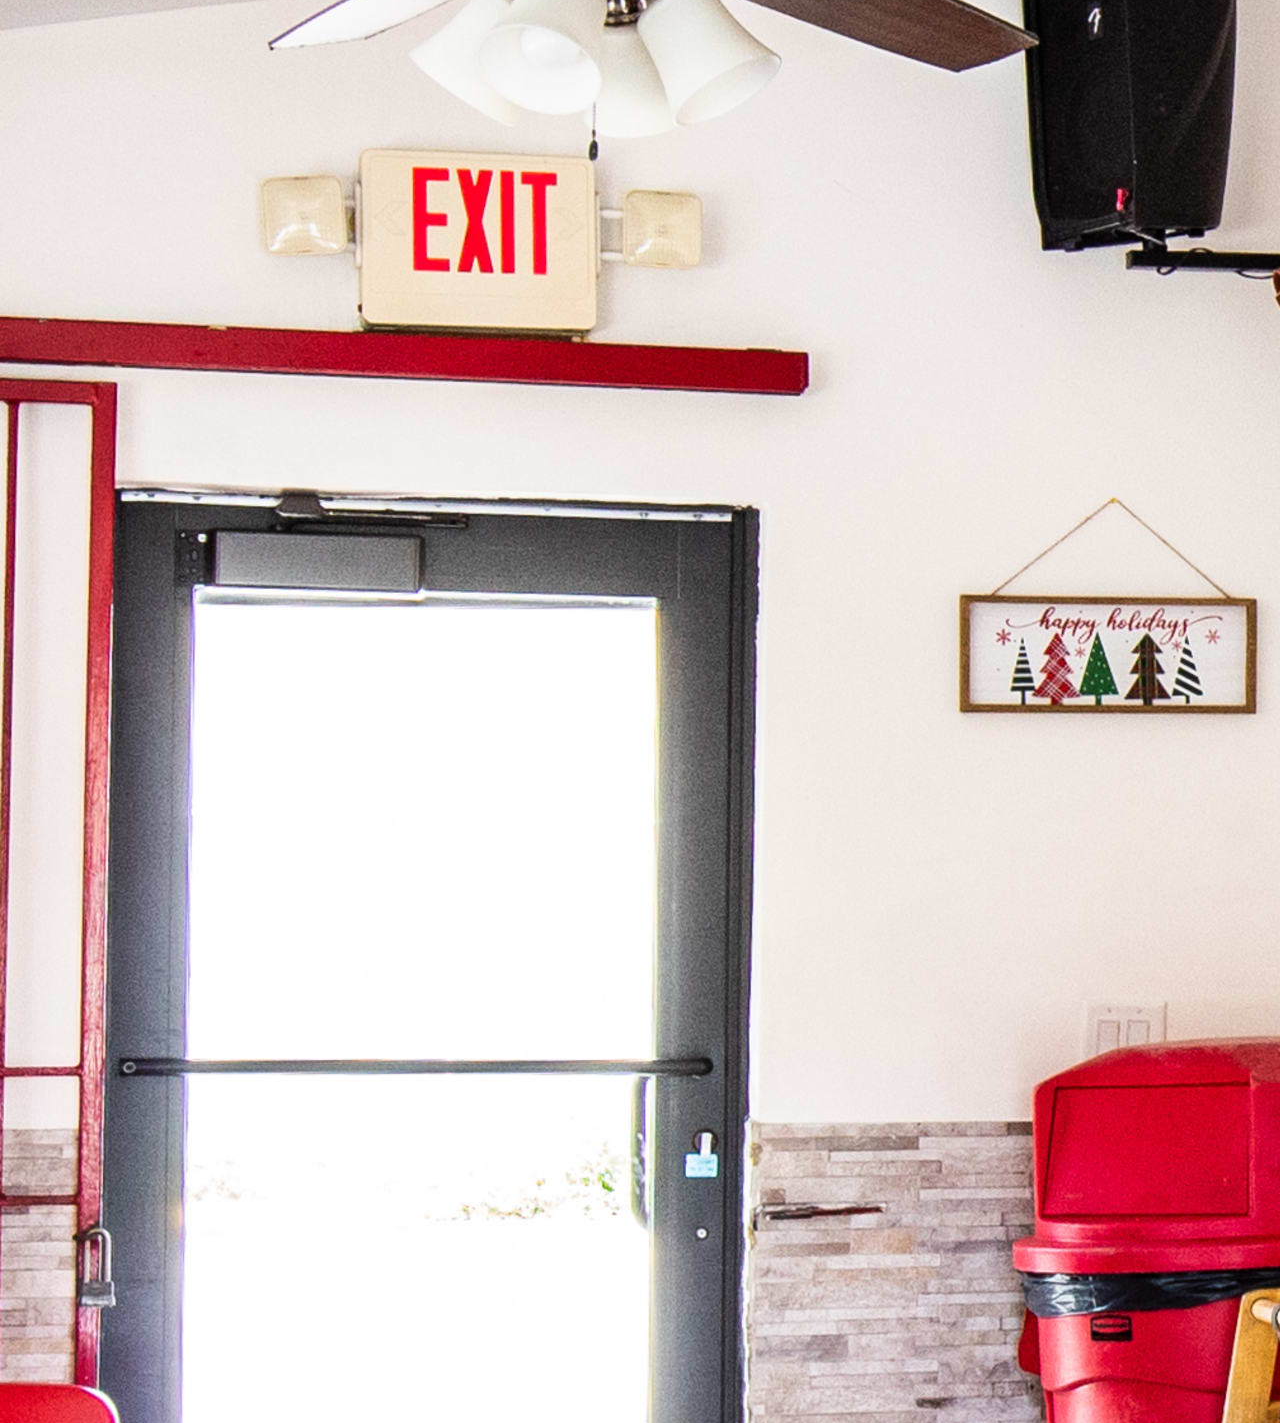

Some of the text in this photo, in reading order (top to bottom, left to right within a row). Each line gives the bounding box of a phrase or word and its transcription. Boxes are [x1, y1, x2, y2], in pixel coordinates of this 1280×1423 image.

[411, 166, 558, 275] EXIT
[1006, 606, 1224, 646] happy holidays
